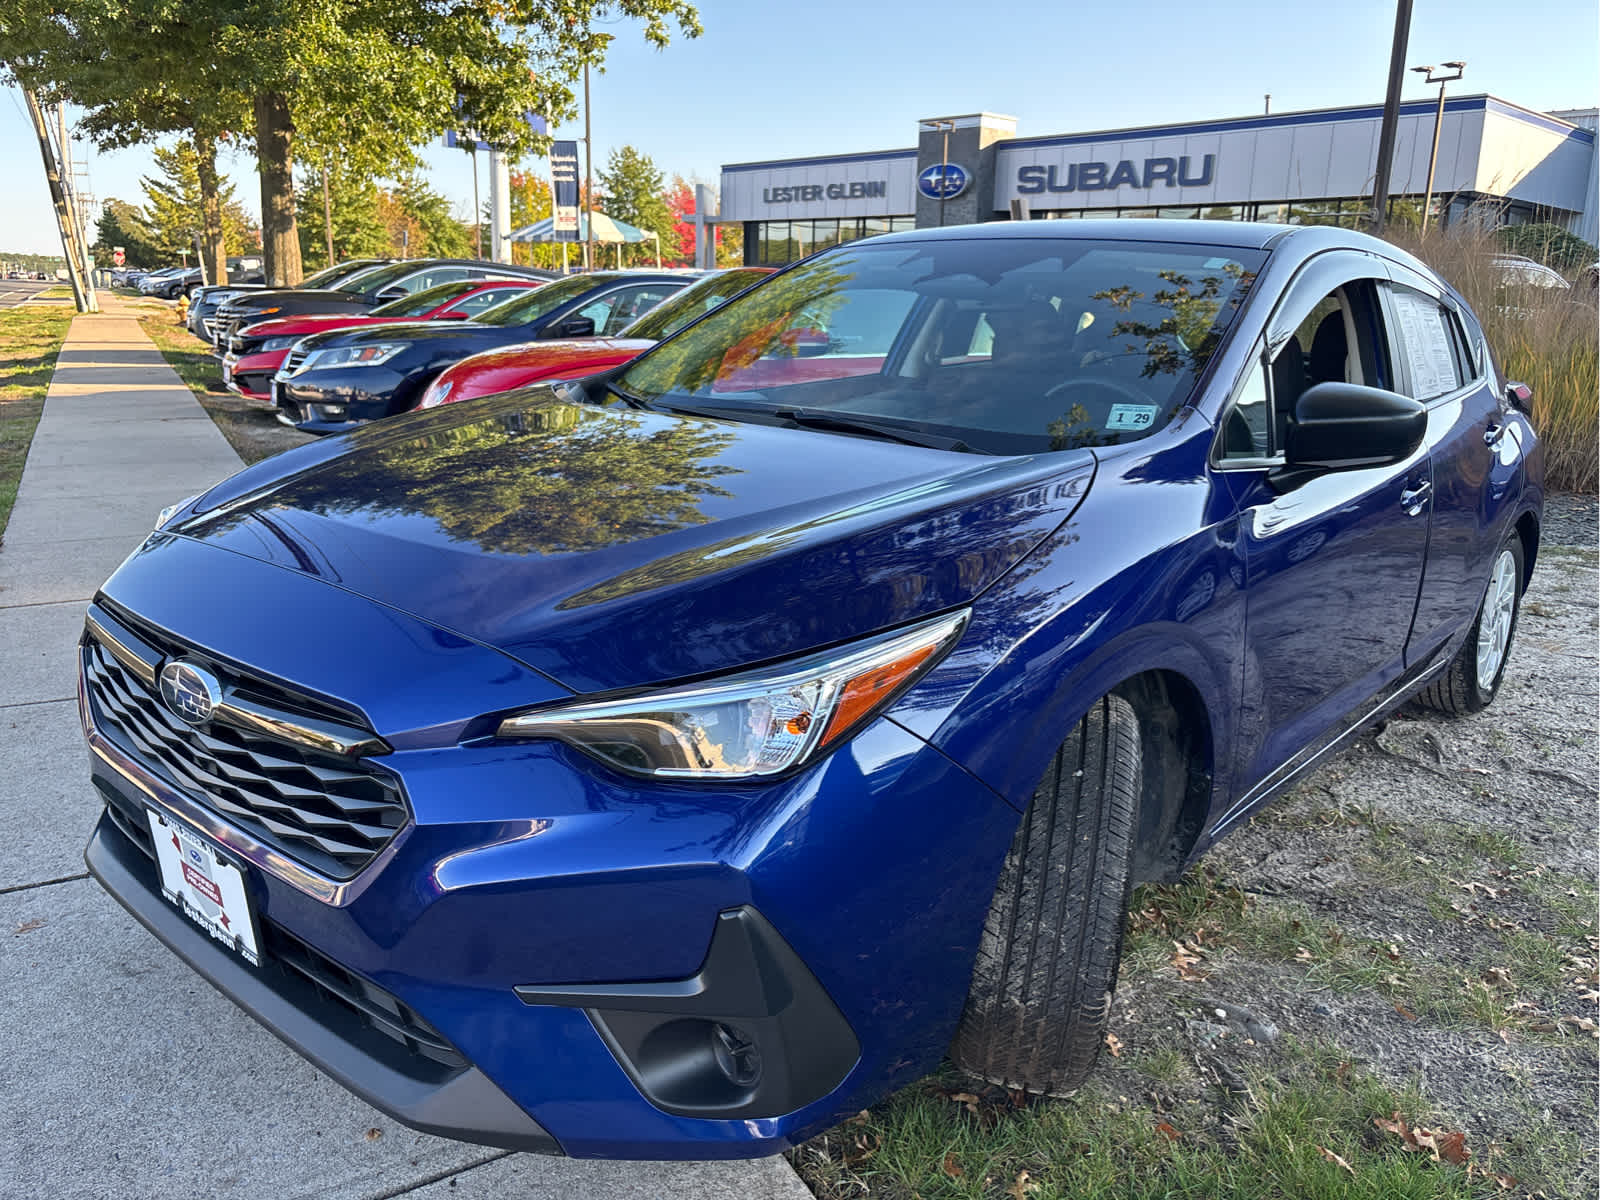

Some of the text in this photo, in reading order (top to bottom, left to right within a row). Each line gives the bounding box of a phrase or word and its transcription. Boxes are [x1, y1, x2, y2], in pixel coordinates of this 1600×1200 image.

[1016, 154, 1216, 195] SUBARU
[763, 180, 887, 204] LESTER GLENN
[1116, 413, 1150, 424] 1 29
